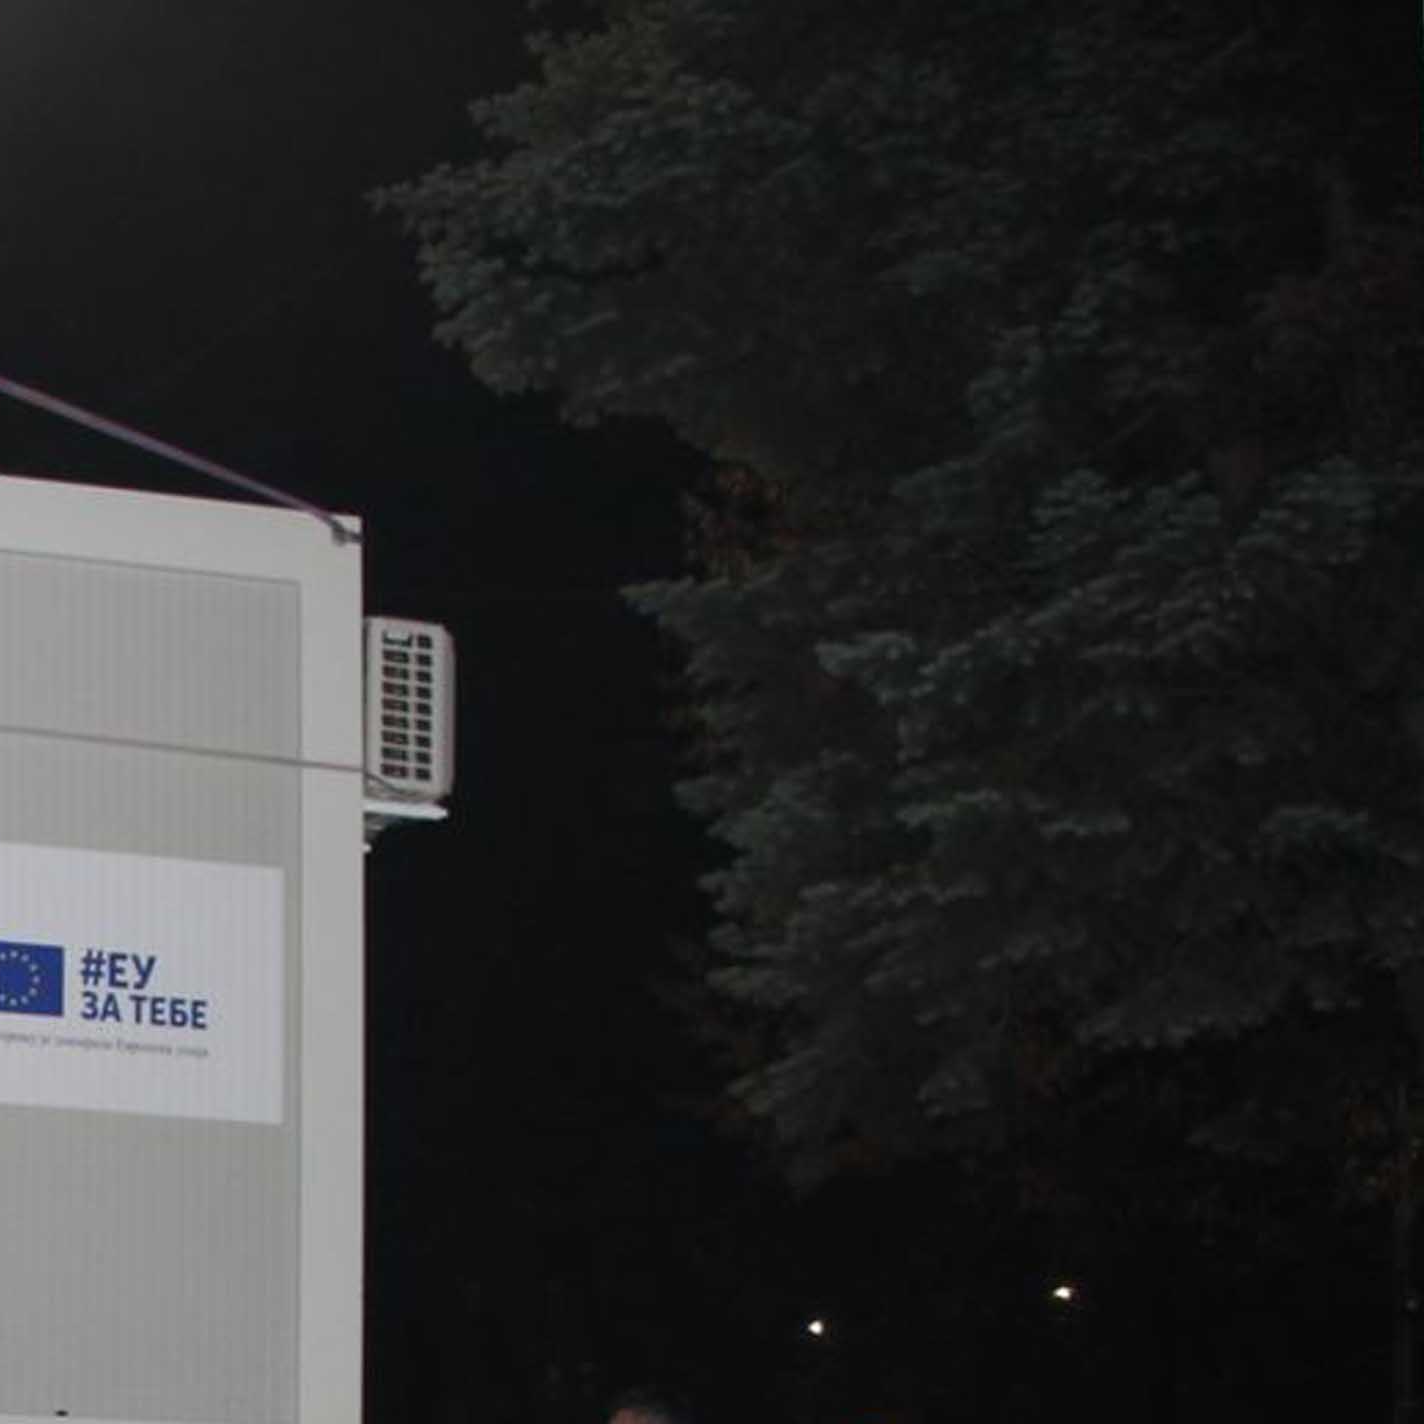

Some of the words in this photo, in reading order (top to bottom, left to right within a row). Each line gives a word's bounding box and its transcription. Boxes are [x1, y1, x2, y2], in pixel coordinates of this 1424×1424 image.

[80, 949, 156, 989] #ЕУ
[81, 991, 121, 1023] ЗА
[129, 995, 208, 1030] ТЕБЕ
